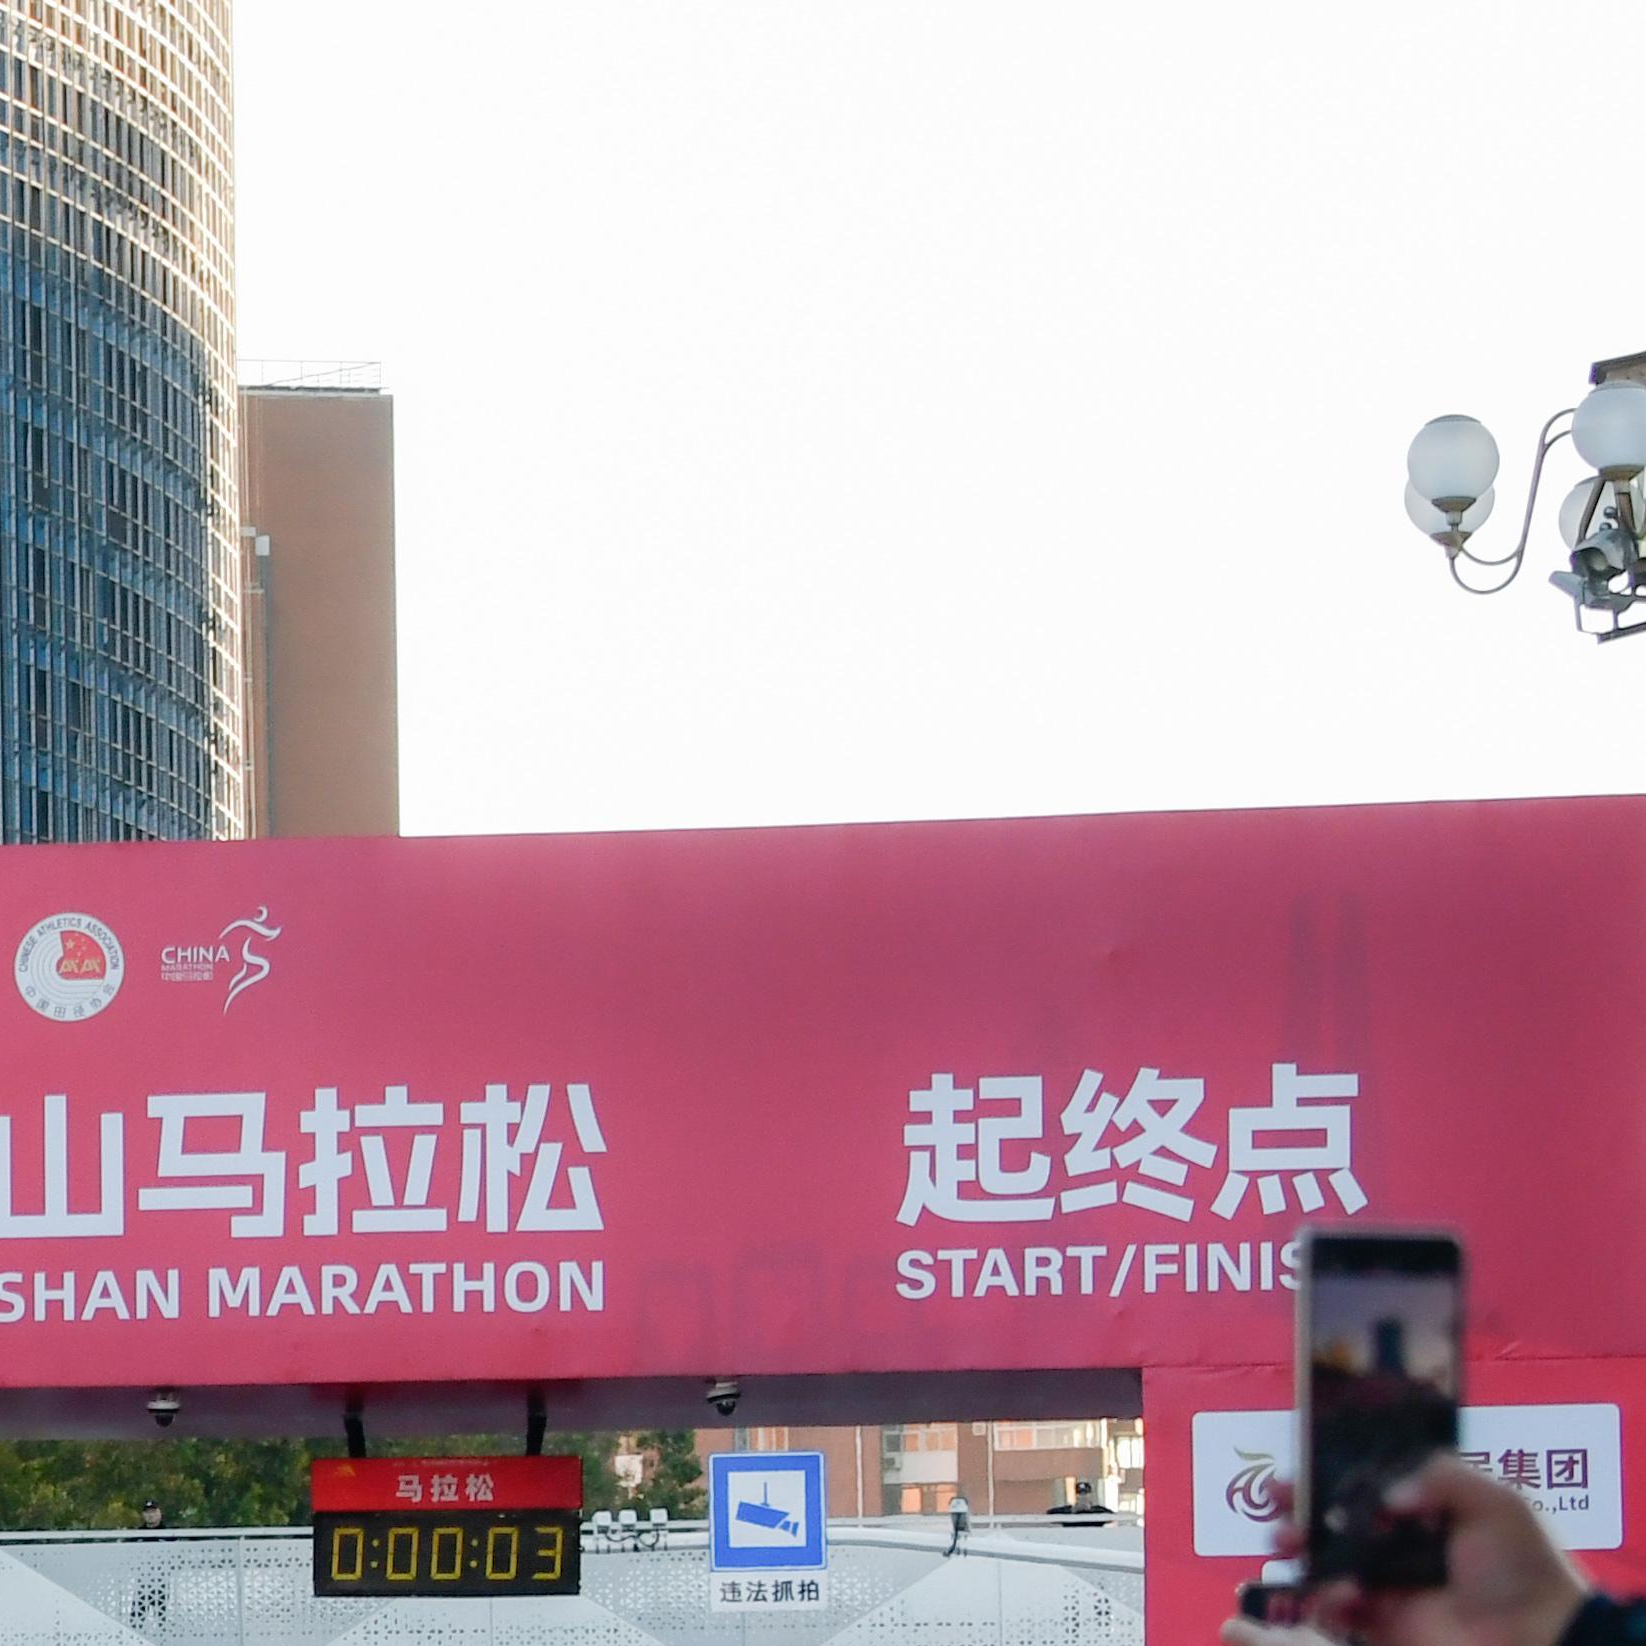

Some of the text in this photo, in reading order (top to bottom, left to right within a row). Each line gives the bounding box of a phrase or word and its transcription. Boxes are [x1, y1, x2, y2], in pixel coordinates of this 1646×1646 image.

[18, 917, 120, 973] CHINESE ATHLETICS ASSOCIATION
[161, 945, 230, 964] CHINA
[895, 1062, 1369, 1227] 起终点
[207, 1260, 605, 1318] MARATHON
[895, 1243, 1303, 1300] START/FINIS
[395, 1474, 494, 1503] 马拉松
[330, 1526, 564, 1580] 0:00:03
[720, 1579, 820, 1603] 违法抓拍
